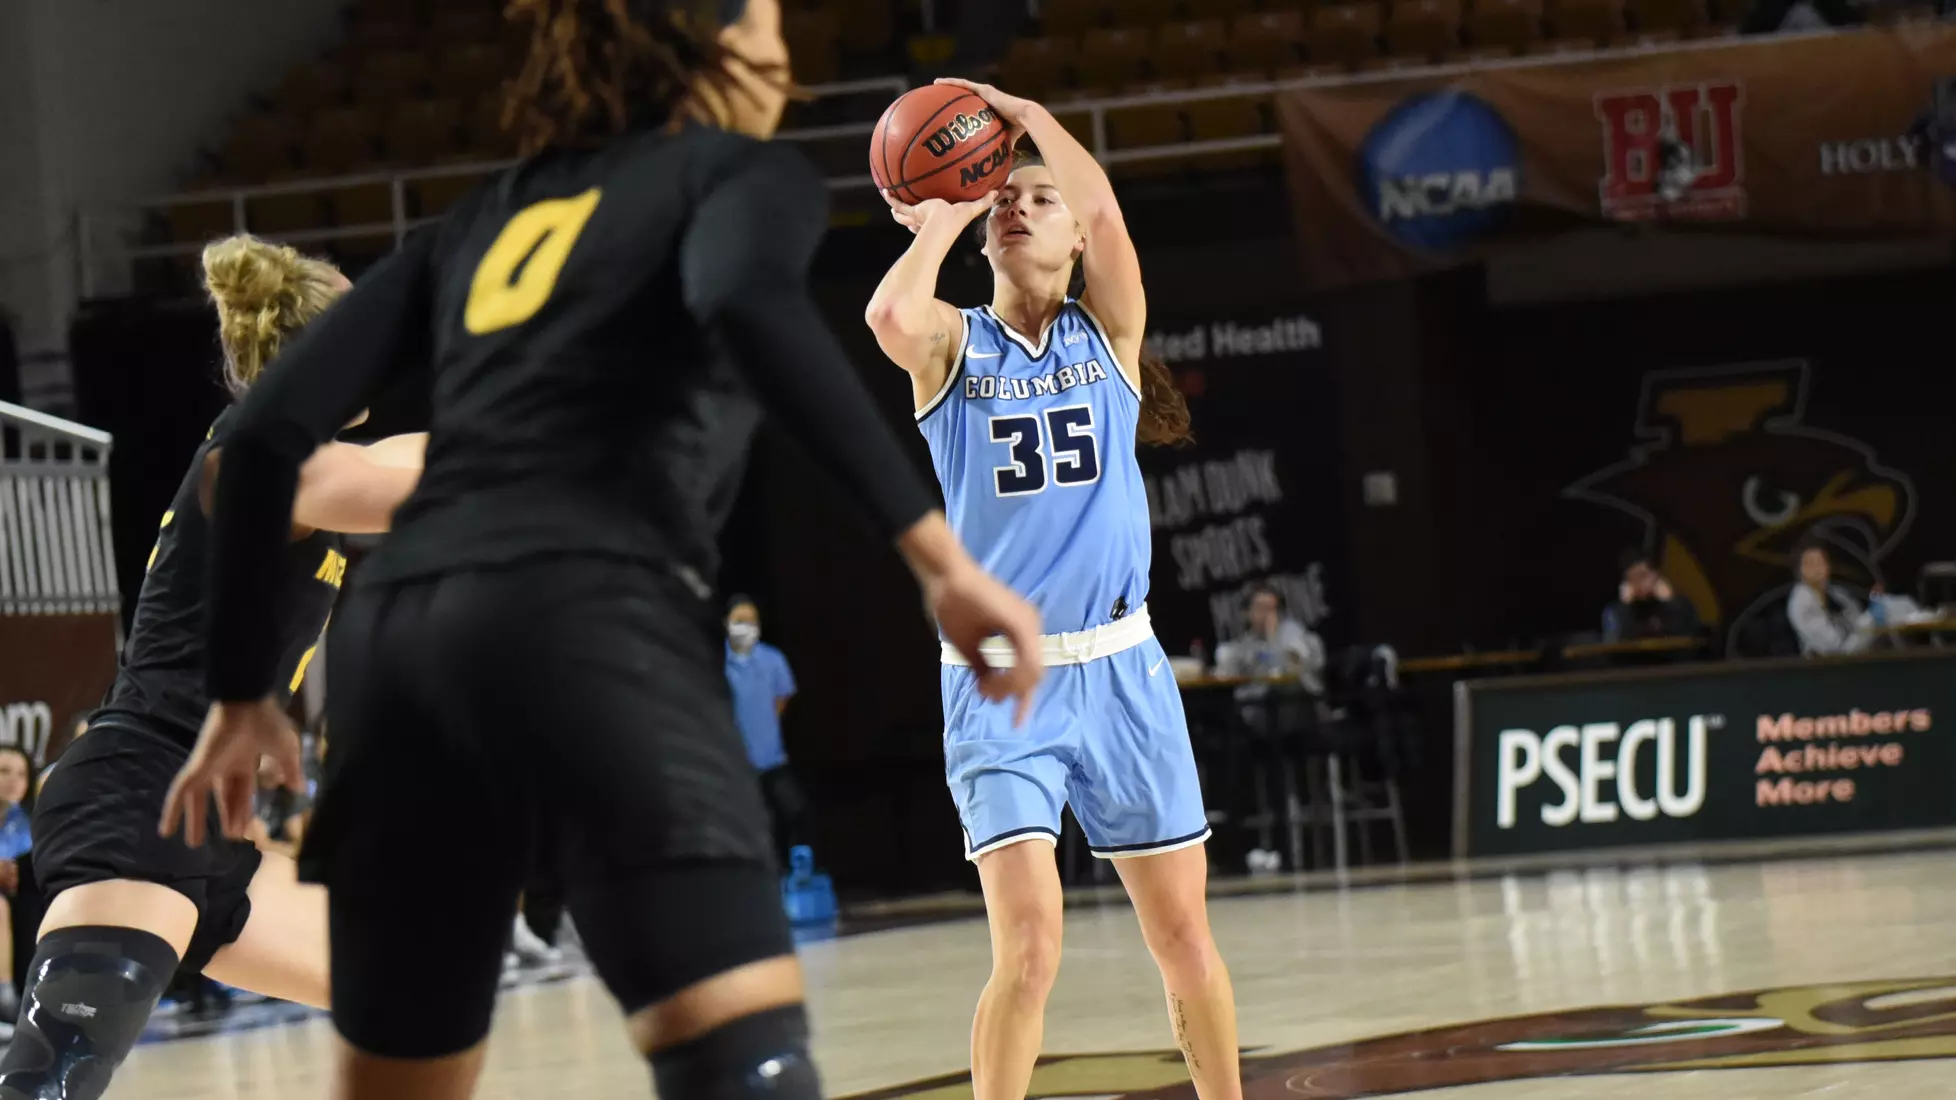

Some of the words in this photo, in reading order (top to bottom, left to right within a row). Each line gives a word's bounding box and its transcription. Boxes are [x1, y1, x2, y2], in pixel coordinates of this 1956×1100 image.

[960, 140, 1009, 187] NCAA
[1819, 135, 1922, 175] HOLY
[1378, 167, 1520, 221] NCAA
[463, 187, 603, 336] 0
[1149, 326, 1207, 362] ted
[1212, 315, 1323, 358] Health
[965, 358, 1107, 401] COLUMBIA
[988, 403, 1102, 498] 35
[1146, 463, 1206, 528] LAM
[1204, 448, 1284, 515] DUNK
[1170, 515, 1274, 592] SPORTS
[1756, 708, 1932, 744] Members
[1497, 714, 1708, 829] PSECU
[1754, 741, 1904, 775] Achieve
[1755, 777, 1855, 808] More
